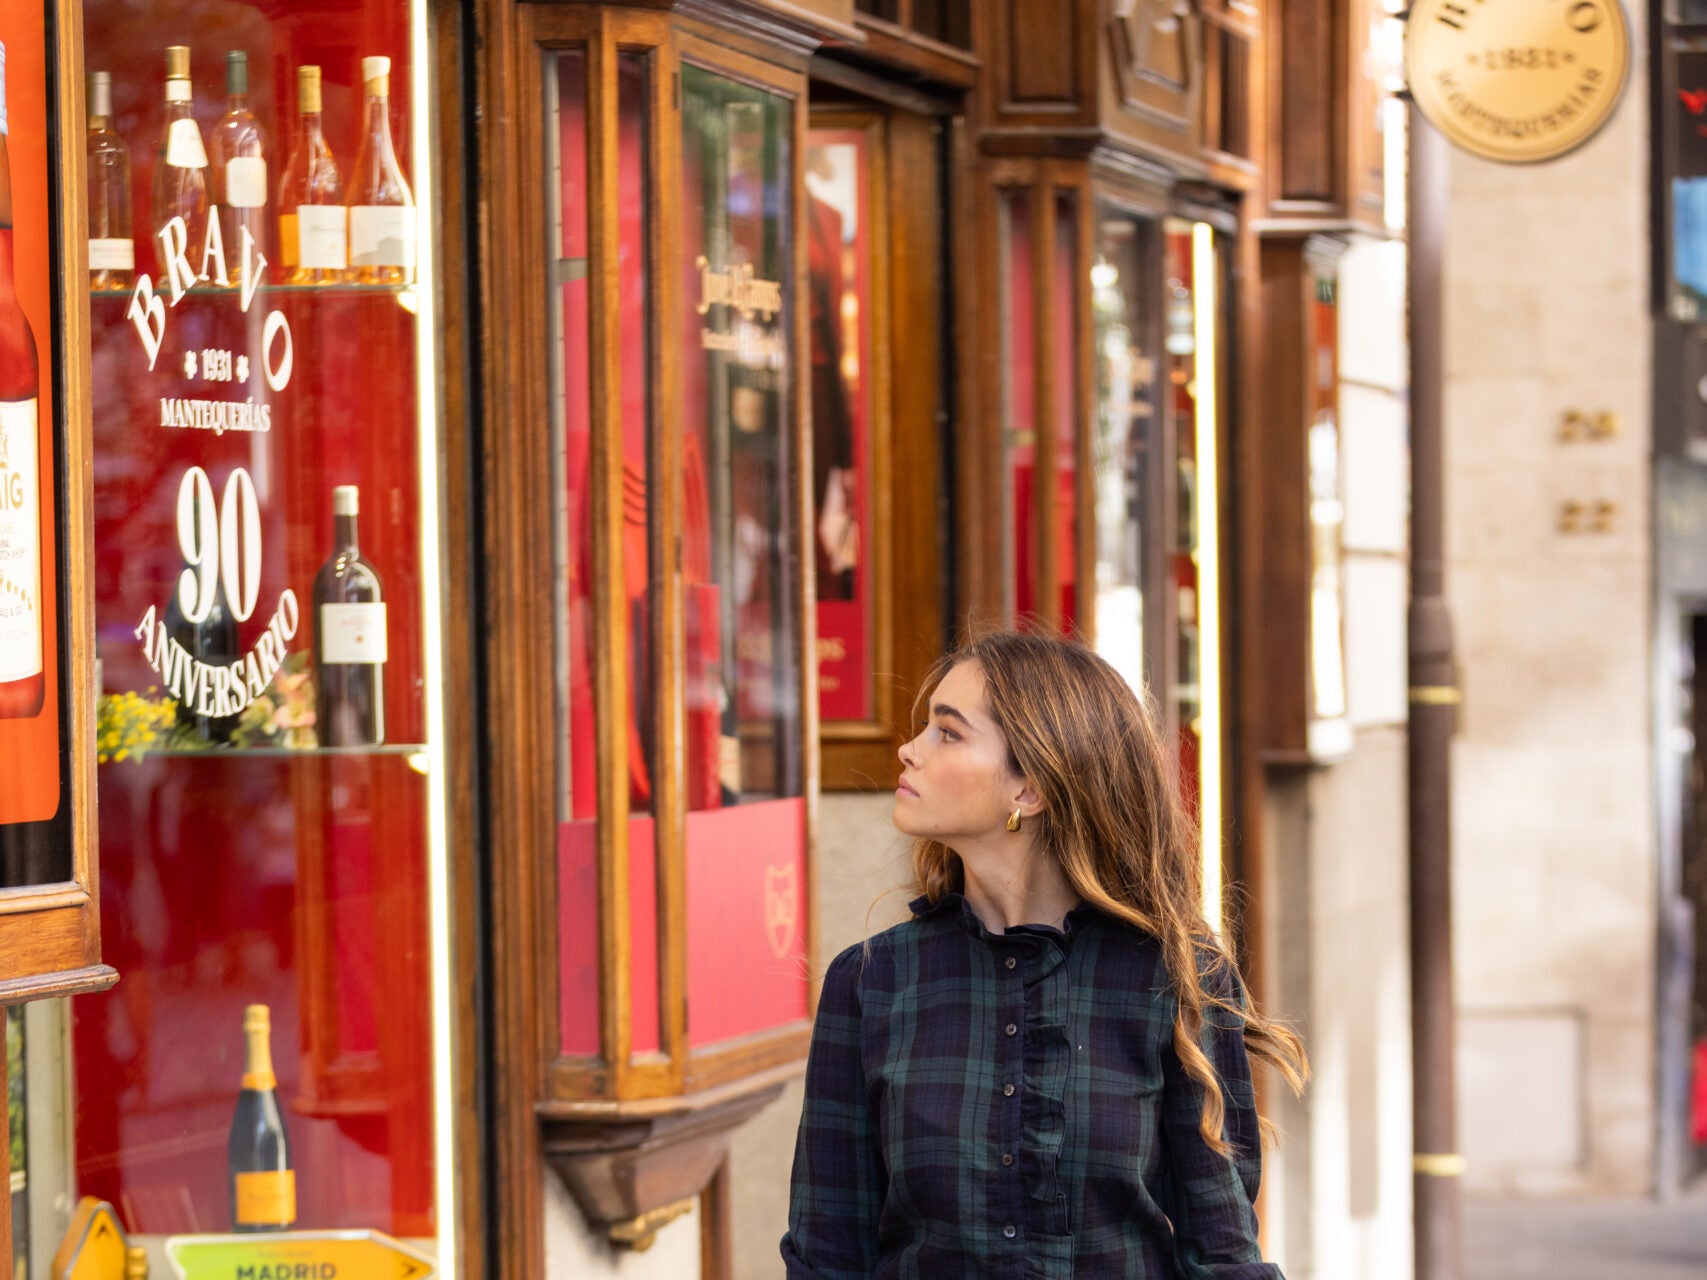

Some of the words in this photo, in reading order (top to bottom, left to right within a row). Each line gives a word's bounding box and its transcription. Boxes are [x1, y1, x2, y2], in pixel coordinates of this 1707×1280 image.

[127, 204, 293, 391] BRAVO
[160, 396, 271, 436] MANTEQUERÍAS
[201, 348, 232, 382] 1931
[176, 466, 262, 624] 90
[133, 588, 298, 718] ANIVERSARIO
